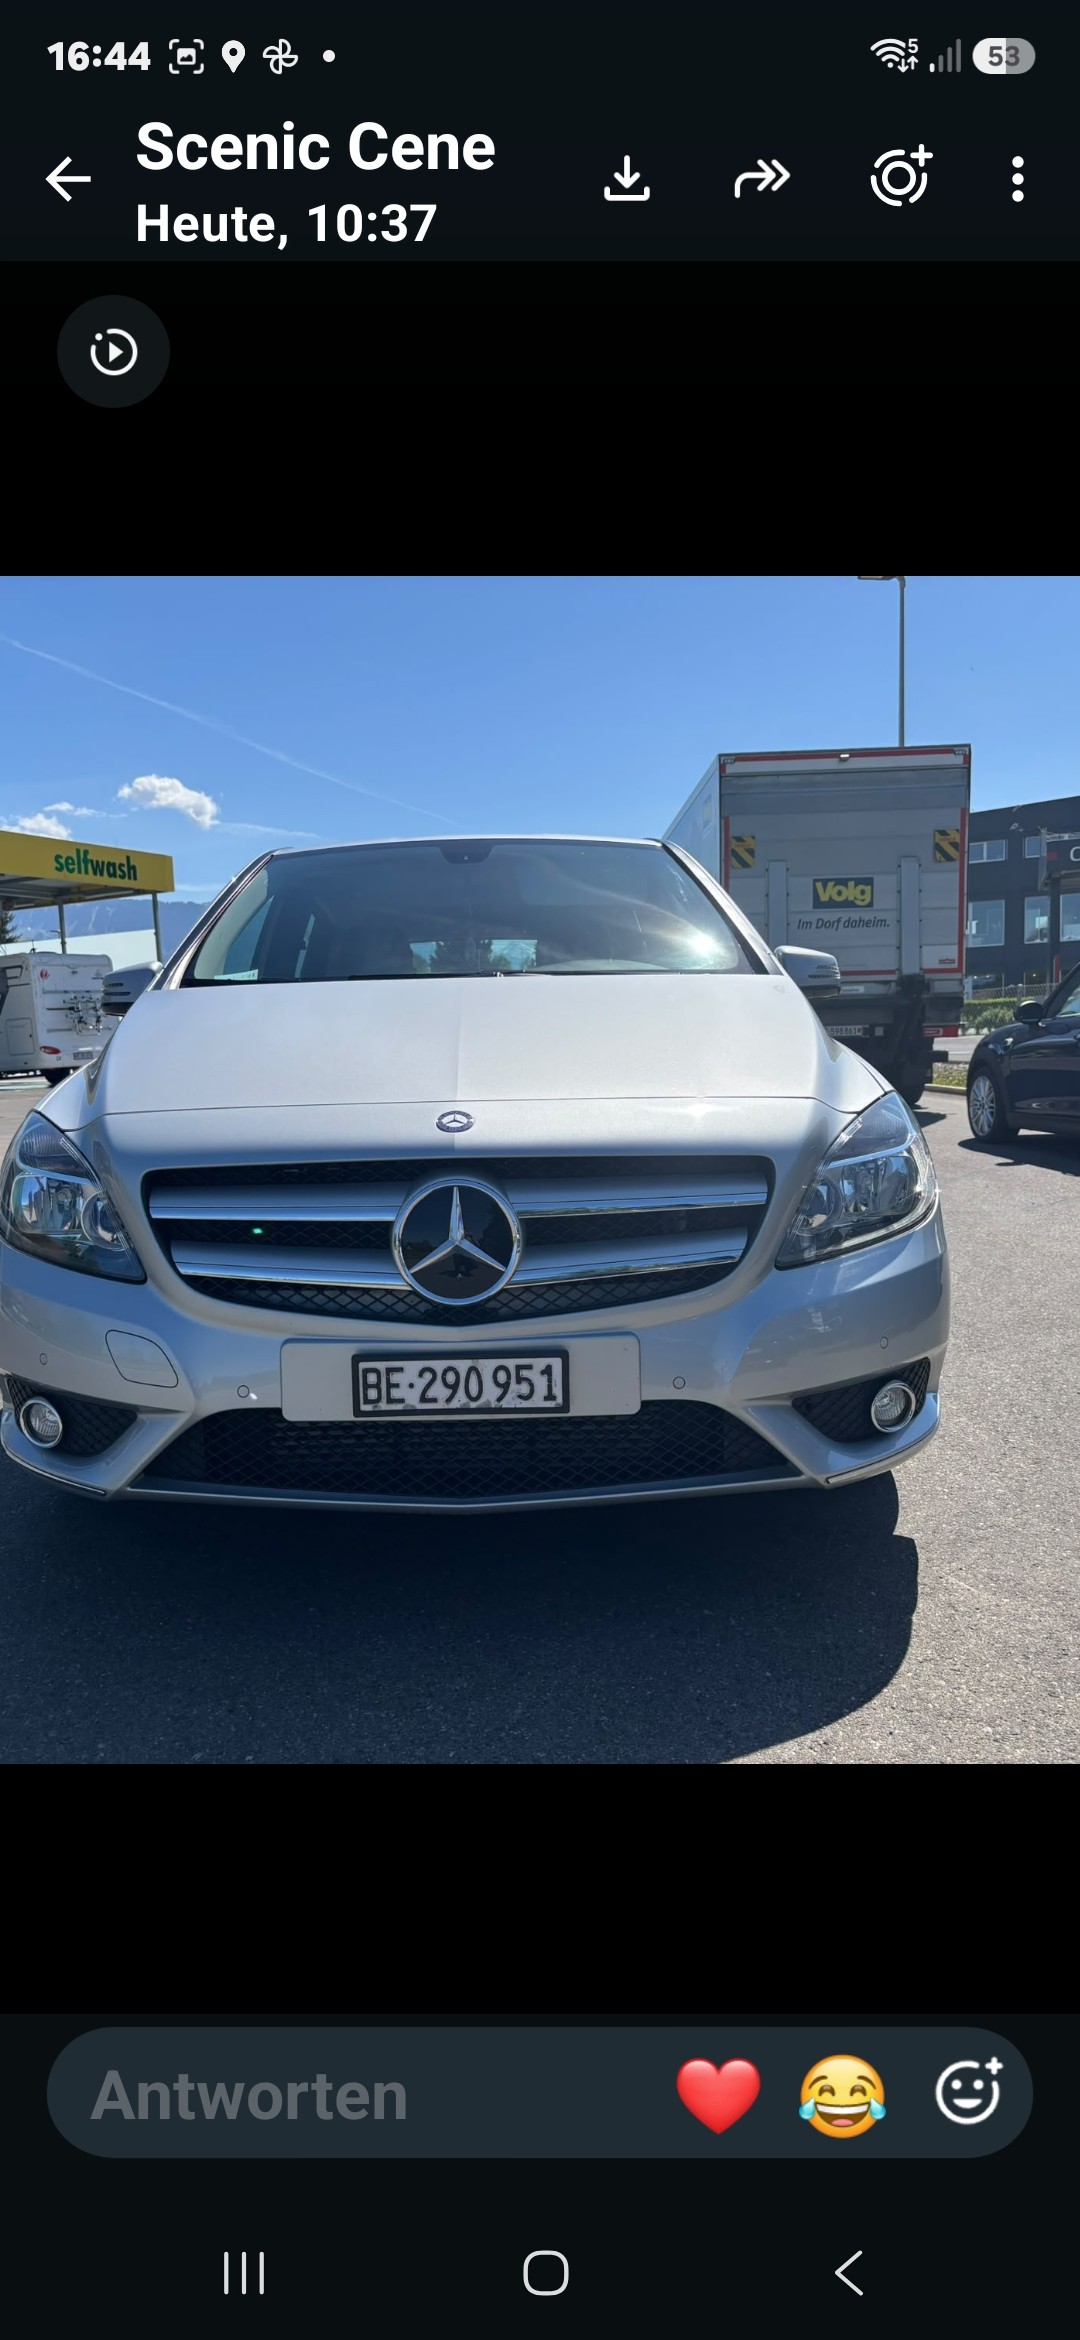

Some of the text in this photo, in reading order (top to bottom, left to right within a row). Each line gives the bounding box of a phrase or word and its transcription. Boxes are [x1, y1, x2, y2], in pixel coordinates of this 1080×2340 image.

[54, 848, 138, 881] selfwash
[815, 880, 873, 906] Volg
[797, 916, 891, 931] Im Dorf daheim.
